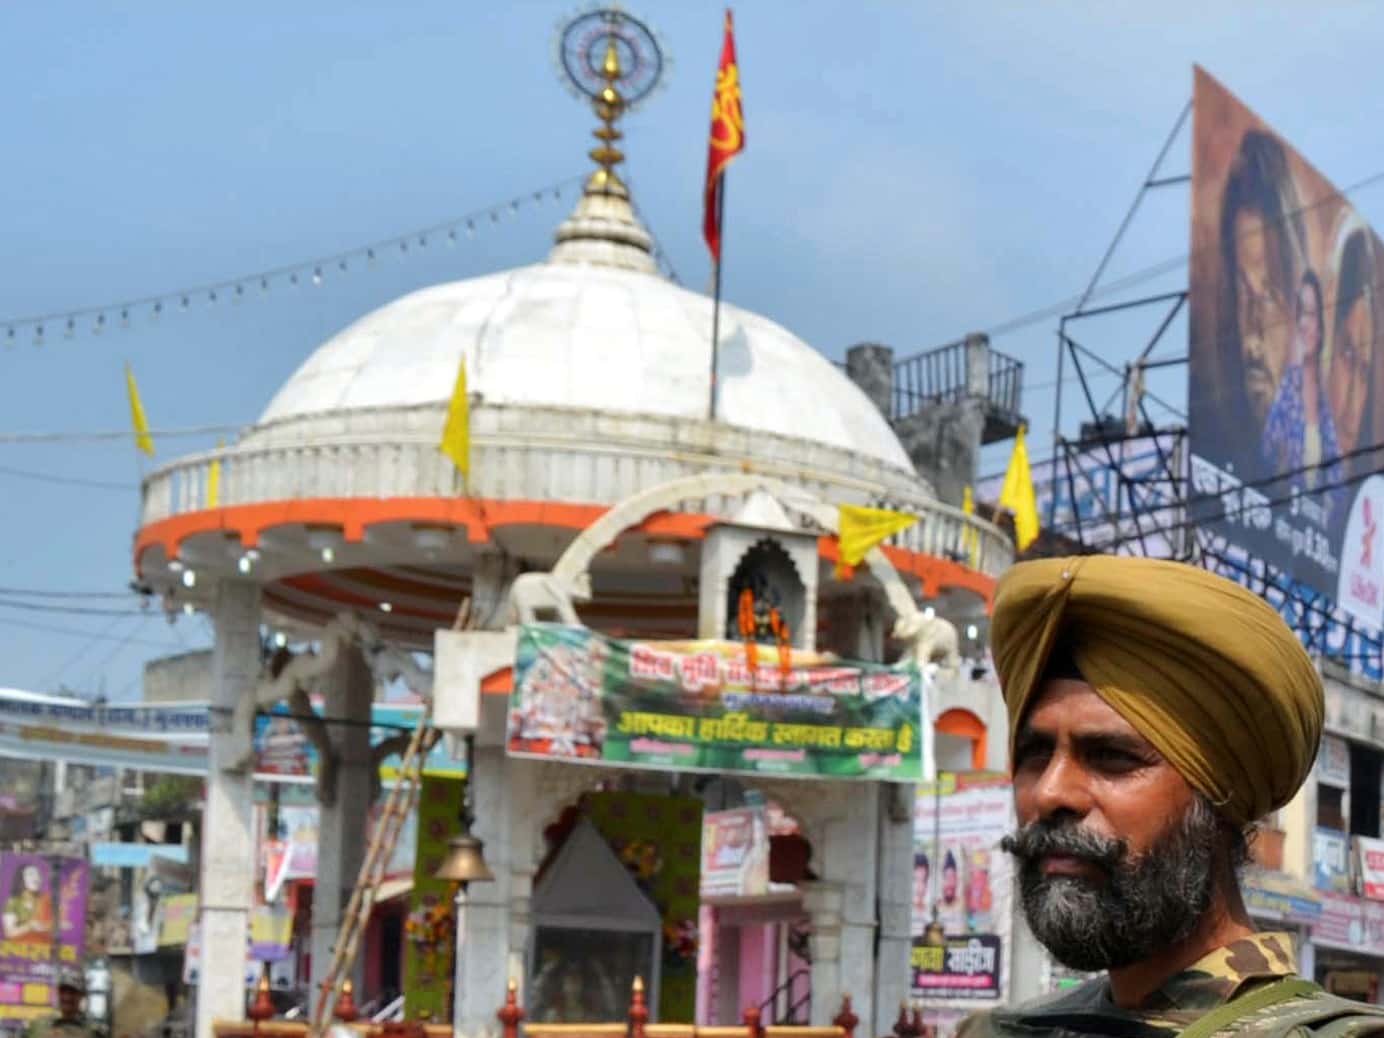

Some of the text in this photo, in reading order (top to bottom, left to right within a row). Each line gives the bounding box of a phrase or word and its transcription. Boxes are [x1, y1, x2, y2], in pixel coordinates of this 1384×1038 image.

[616, 711, 695, 737] आपका
[700, 711, 768, 742] हार्दिक
[772, 722, 842, 748] स्वागत
